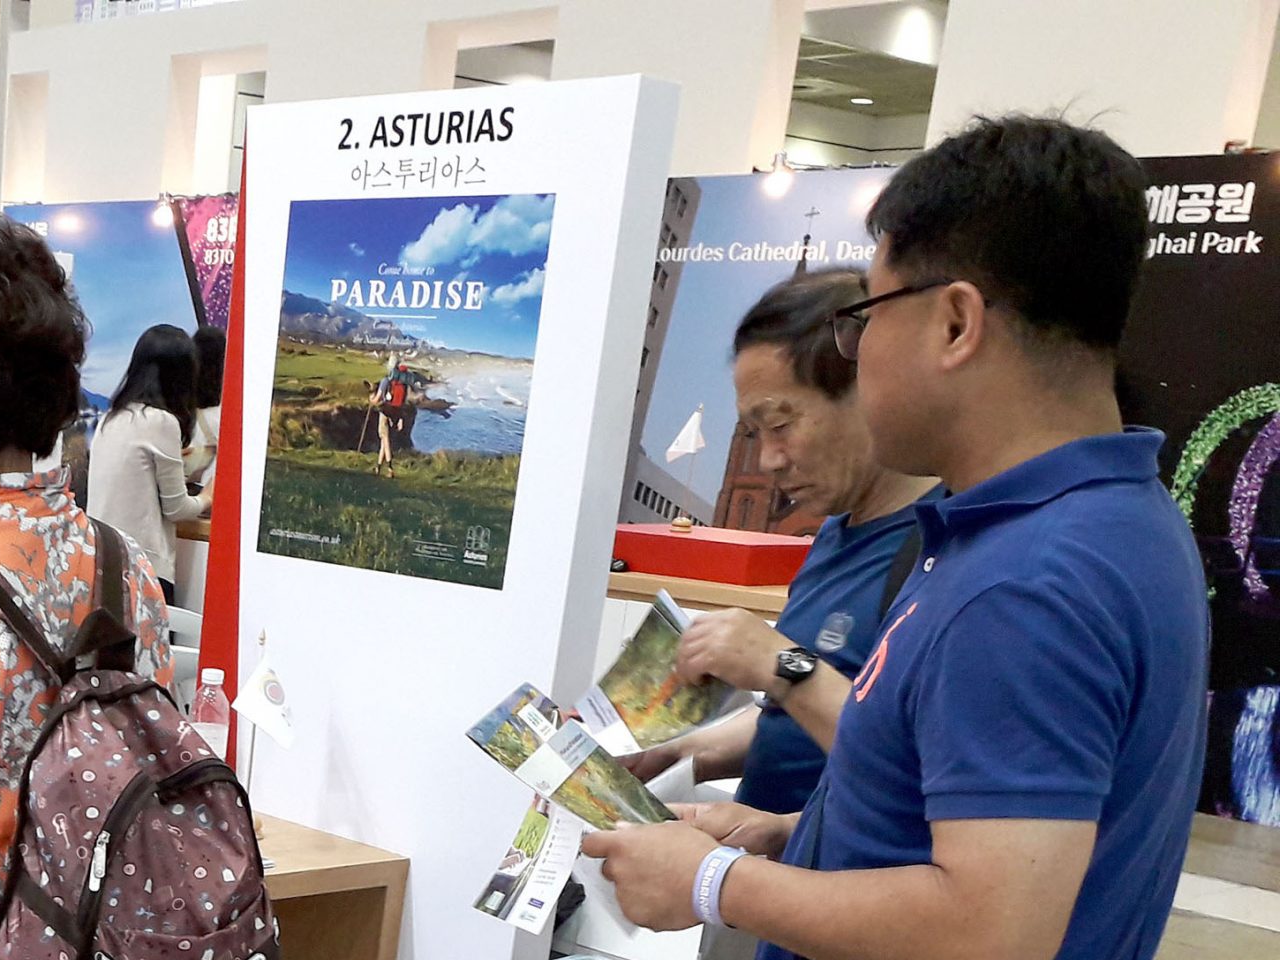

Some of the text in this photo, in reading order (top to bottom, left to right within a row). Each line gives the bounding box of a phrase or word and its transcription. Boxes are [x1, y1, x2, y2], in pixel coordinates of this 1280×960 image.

[337, 107, 515, 150] 2. ASTURIAS
[351, 155, 486, 190] 아스투리아스
[656, 242, 725, 262] ourdes
[729, 240, 829, 264] Cathedral,
[1201, 230, 1263, 254] Park
[425, 265, 435, 276] to
[330, 279, 484, 310] PARADISE
